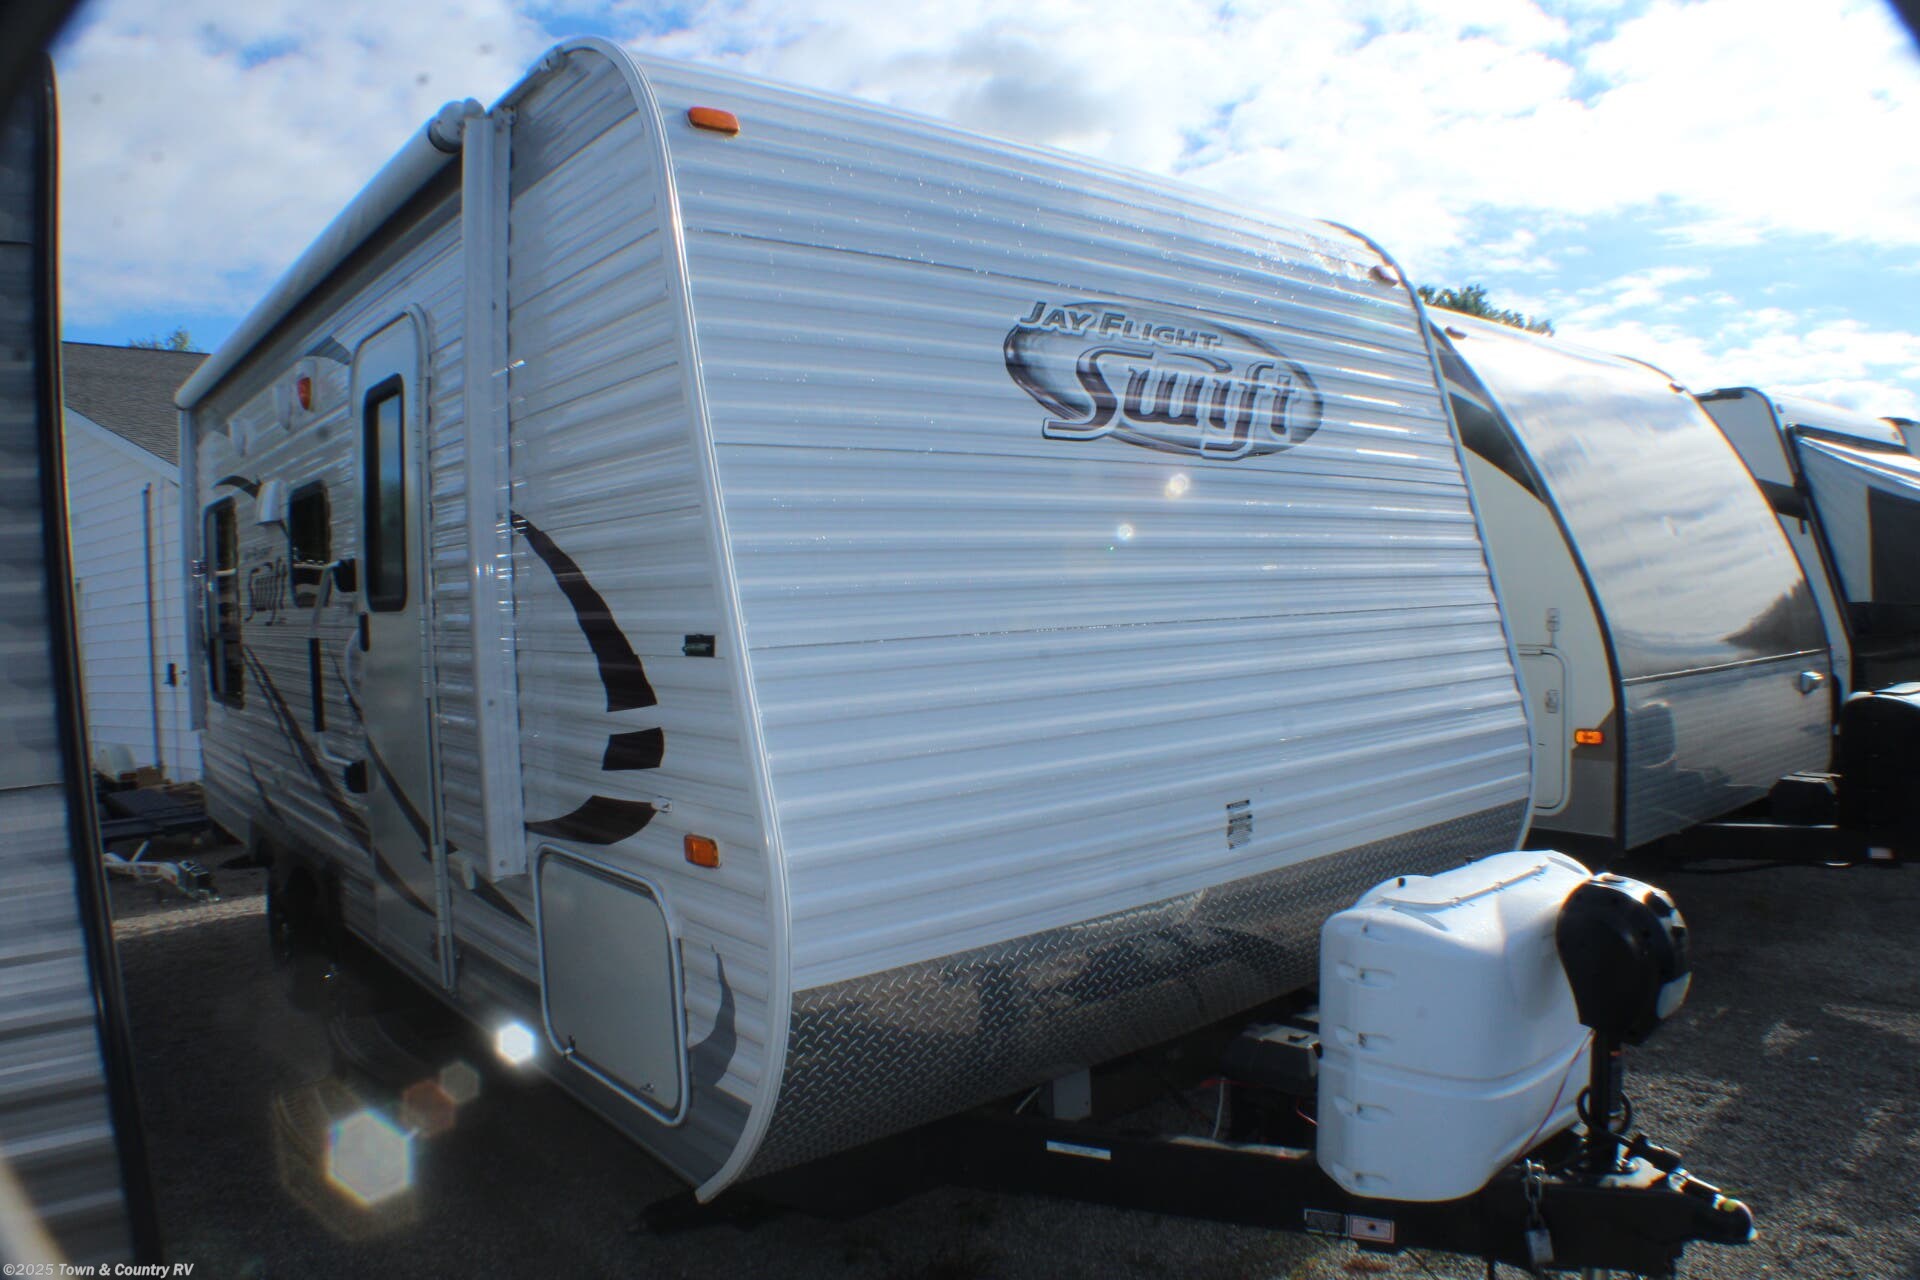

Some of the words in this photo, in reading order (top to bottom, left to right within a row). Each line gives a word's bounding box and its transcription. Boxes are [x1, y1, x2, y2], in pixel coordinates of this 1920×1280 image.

[1019, 301, 1092, 331] JAY
[1099, 312, 1218, 348] FLIGHT
[1043, 346, 1295, 459] Swift
